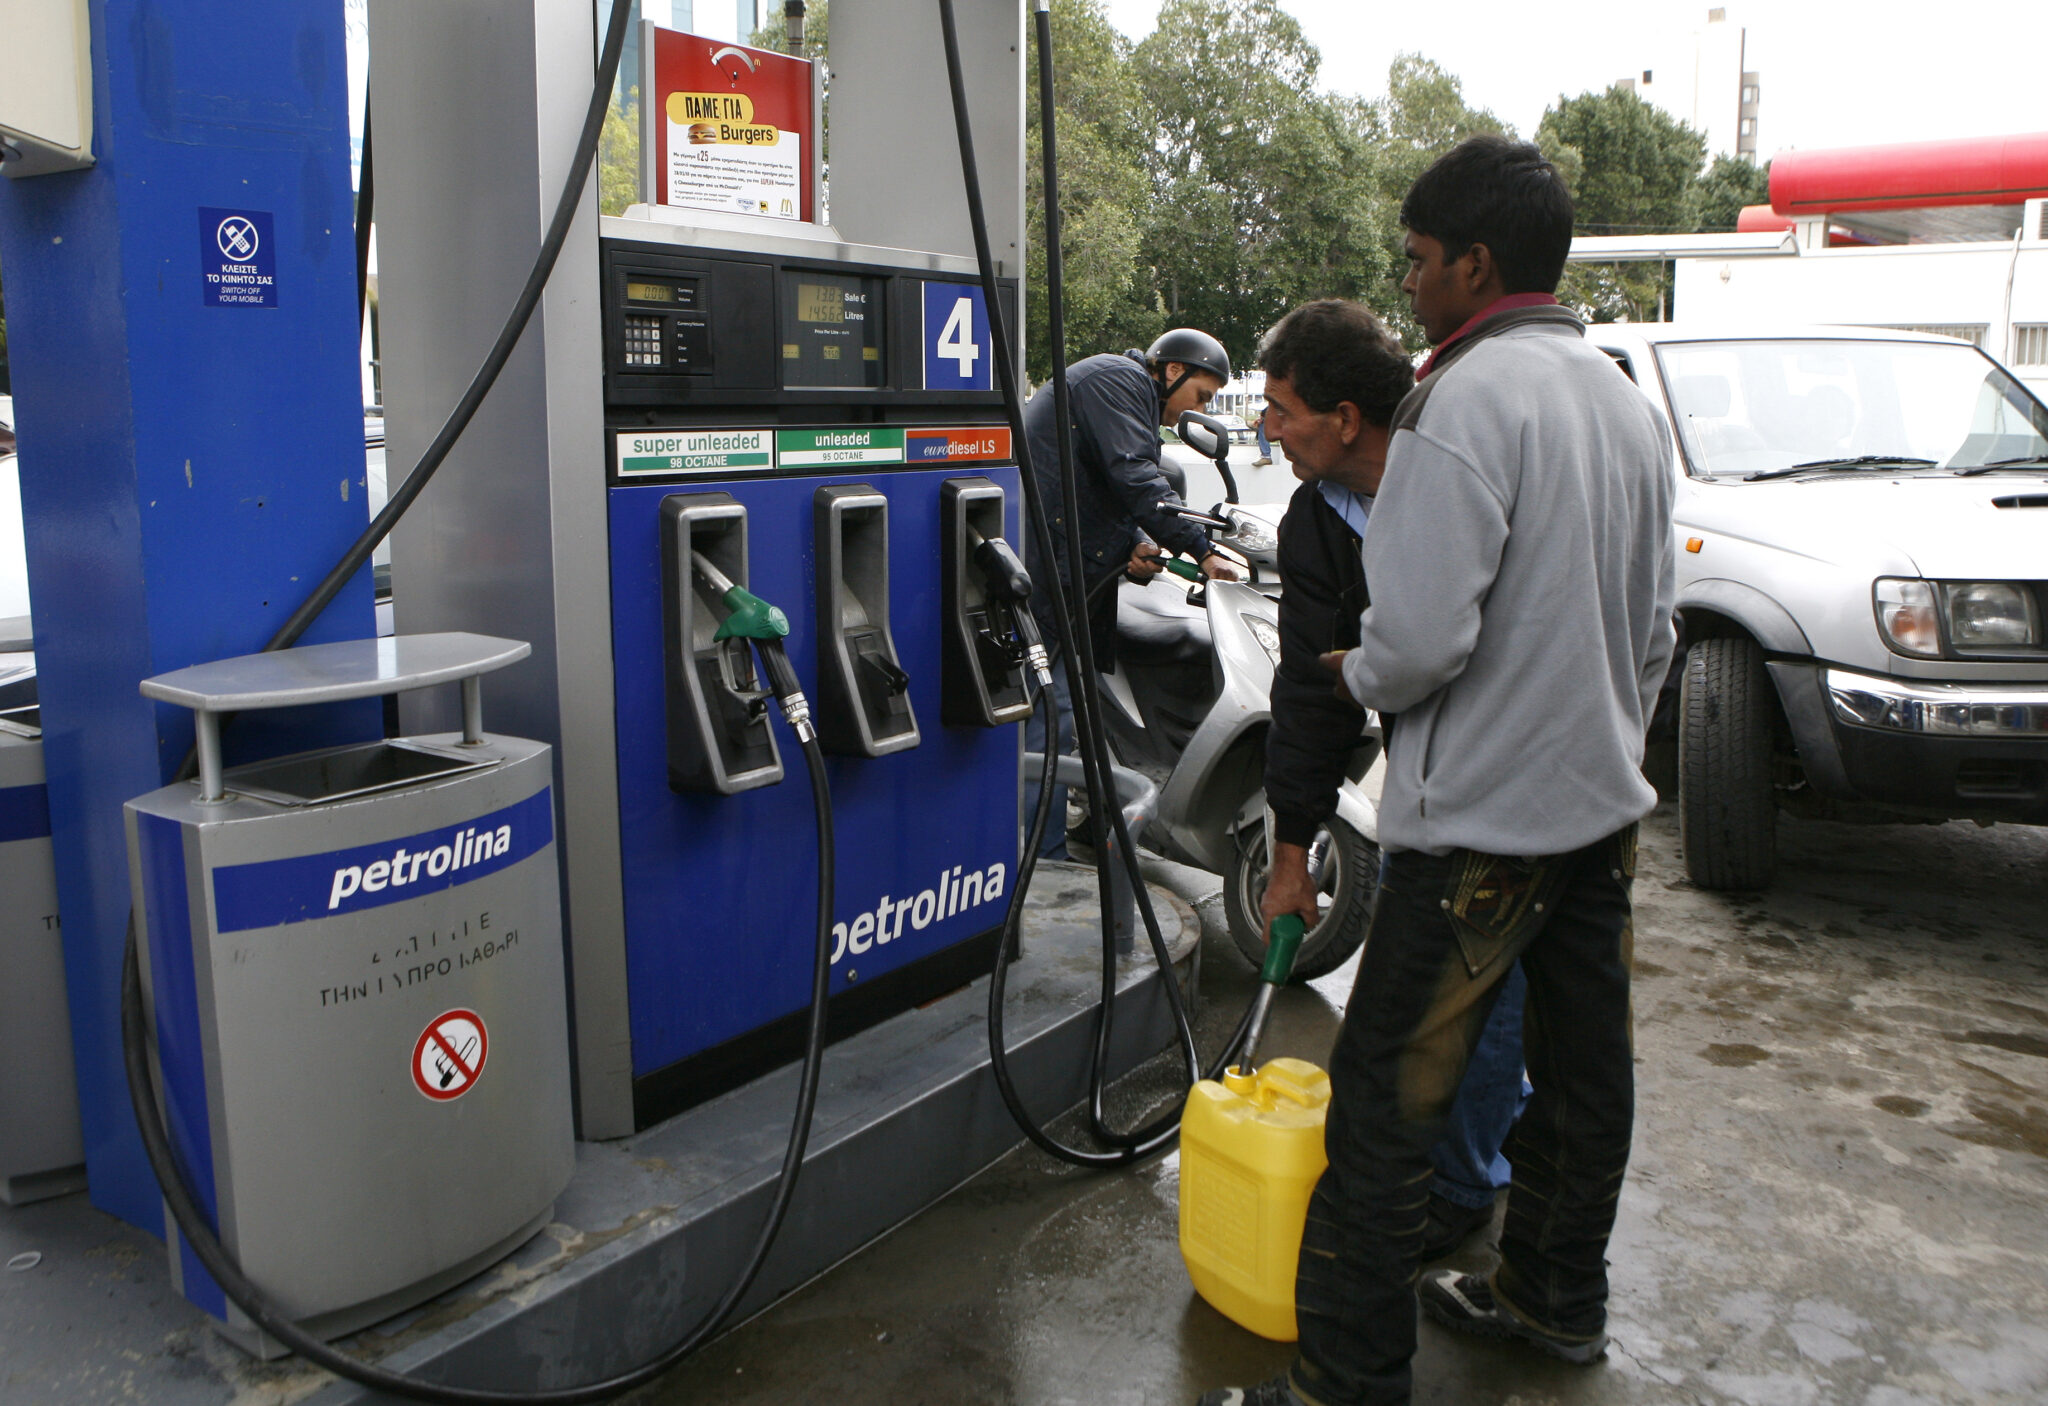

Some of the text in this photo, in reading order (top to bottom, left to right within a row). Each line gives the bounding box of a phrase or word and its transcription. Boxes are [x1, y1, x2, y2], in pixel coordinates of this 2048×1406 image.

[685, 96, 743, 120] ΠΑΜΕ ΓΙΑ
[720, 124, 774, 144] Burgers
[222, 264, 258, 274] ΚΛΕΙΣΤΕ
[206, 273, 273, 285] ΤΟ ΚΙΝΗΤΟ ΣΑΣ
[221, 286, 261, 295] SWITCH OFF
[844, 292, 860, 302] Sale
[218, 295, 264, 303] YOUR MOBILE
[844, 311, 864, 320] Litres
[937, 297, 979, 378] 4
[633, 433, 760, 456] super unleaded
[815, 432, 870, 447] unleaded
[923, 439, 995, 457] eurodiesel LS
[670, 455, 728, 468] 98 OCTANE
[822, 451, 864, 461] 95 OCTANE
[328, 824, 511, 910] petrolina
